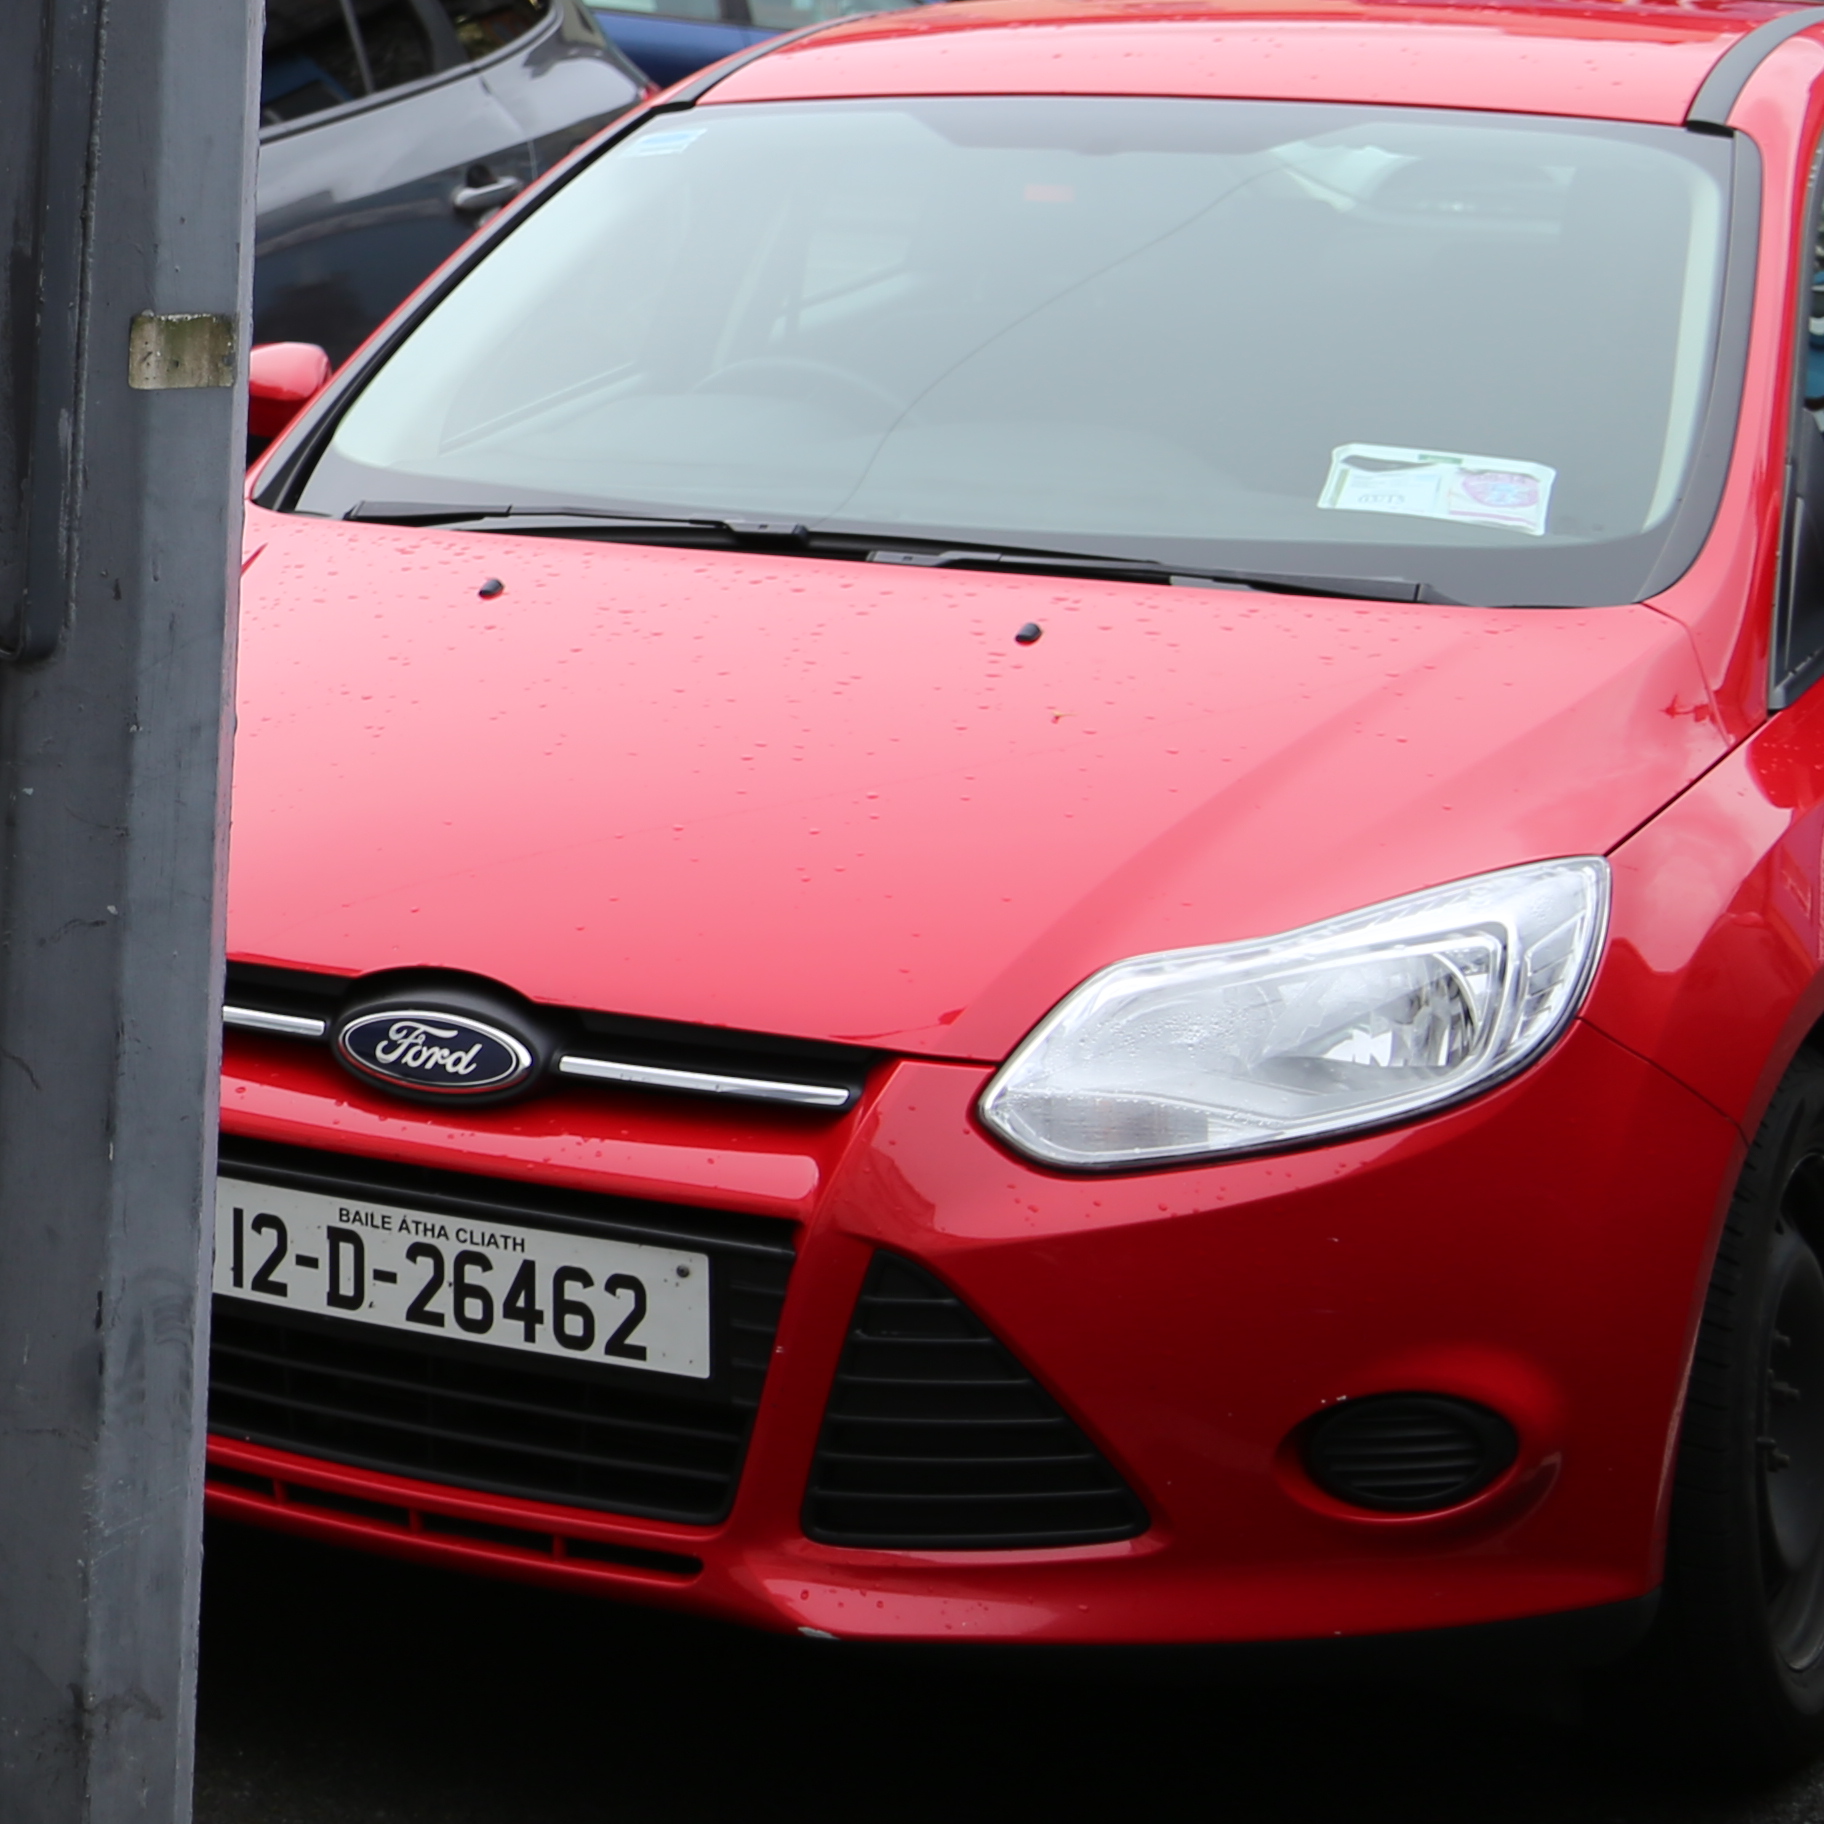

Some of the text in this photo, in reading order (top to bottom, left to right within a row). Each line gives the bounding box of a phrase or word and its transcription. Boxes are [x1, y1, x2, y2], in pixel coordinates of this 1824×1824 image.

[374, 1019, 483, 1076] Ford
[338, 1207, 526, 1254] BAILE ÁTHA CLIATH
[232, 1207, 648, 1362] 12-D-26462
